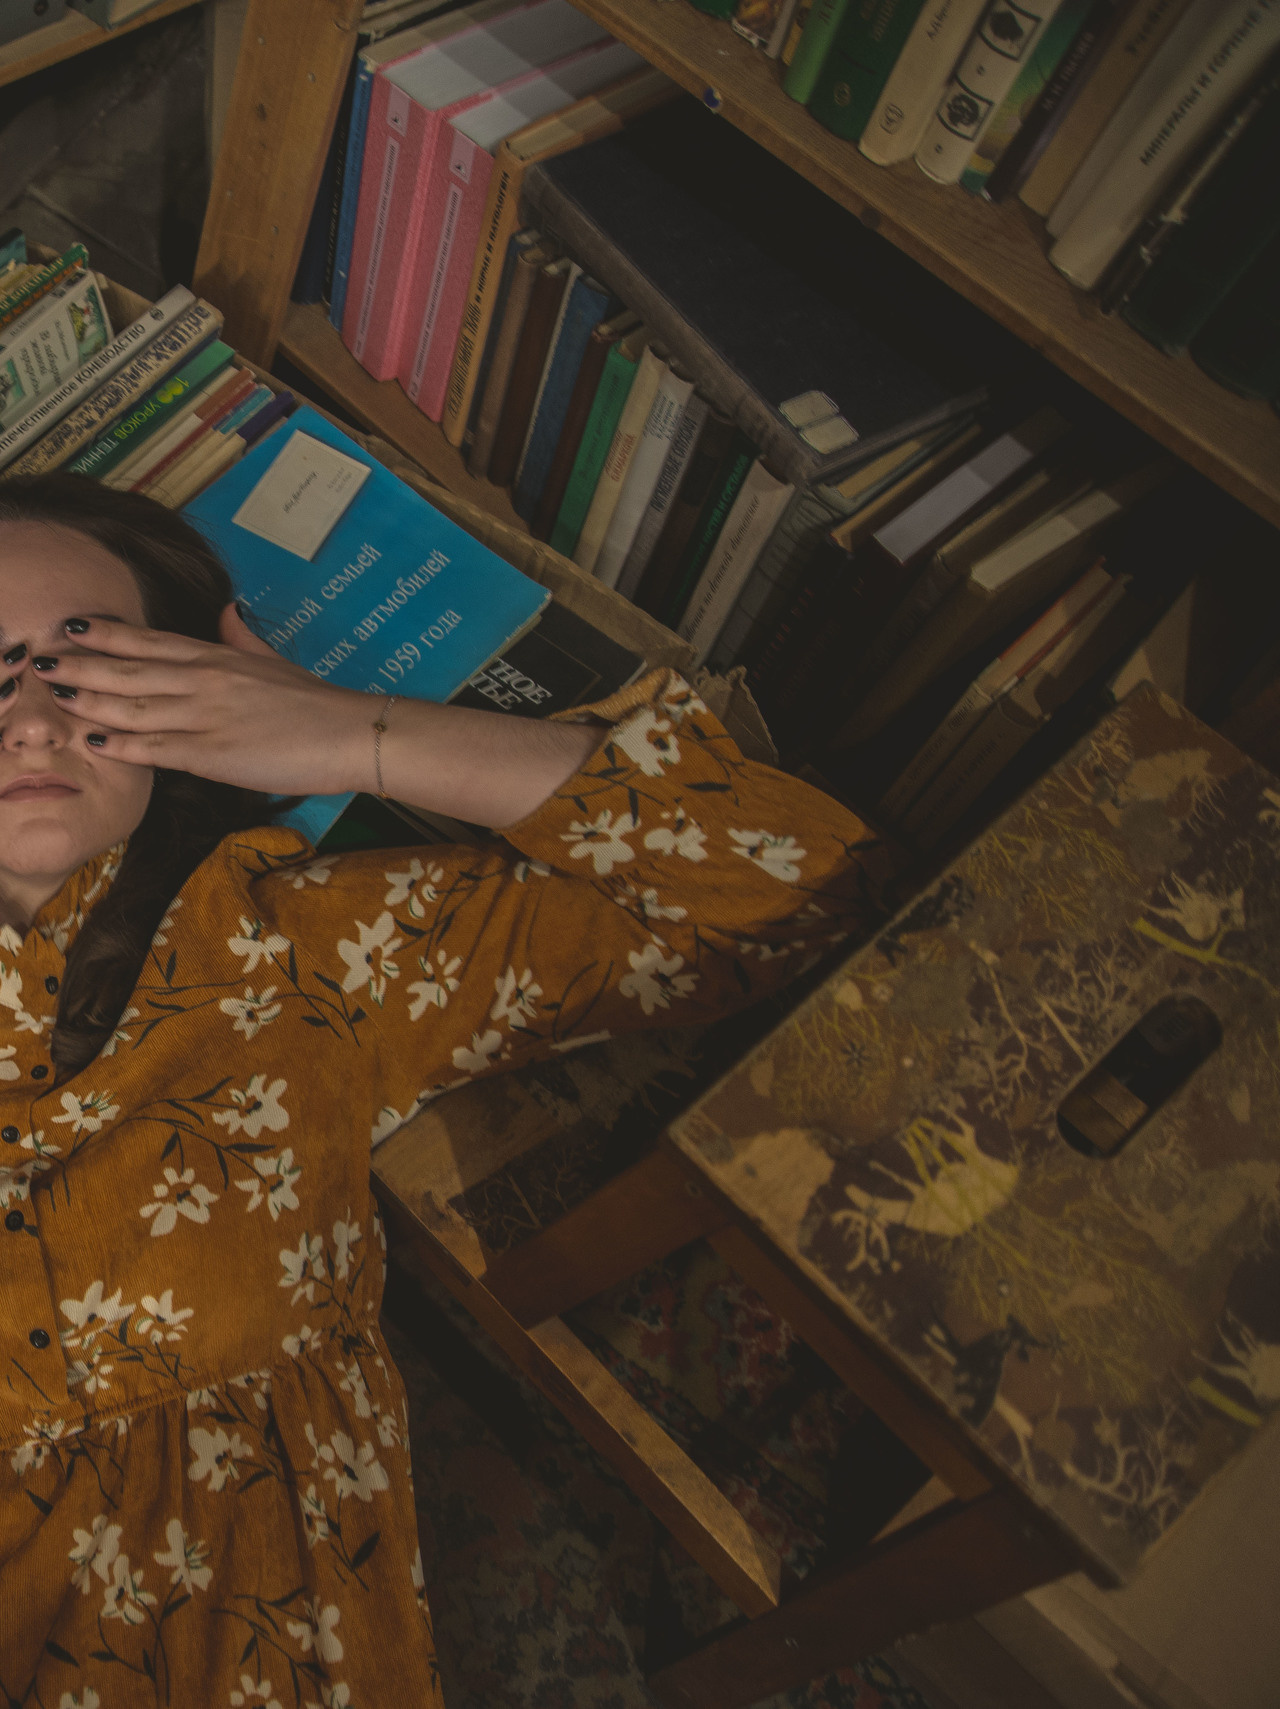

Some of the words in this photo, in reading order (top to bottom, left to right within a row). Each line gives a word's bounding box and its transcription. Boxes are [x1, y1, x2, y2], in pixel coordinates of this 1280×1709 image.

[1136, 85, 1202, 166] МИНЕРАЛЫ
[1194, 71, 1212, 89] И
[1205, 6, 1261, 75] ГОРНЫЕ
[490, 169, 511, 244] ПАТОЛОГИИ
[75, 324, 146, 391] КОНЕВОДСТВО
[114, 400, 163, 441] УРОКОВ
[673, 416, 699, 460] ОПУХОЛИ
[71, 437, 120, 475] ТЕННИС
[717, 452, 751, 502] СУСТАВОВ
[704, 550, 735, 594] детской
[236, 585, 271, 609] т...
[270, 596, 323, 651] льной
[320, 543, 382, 601] семьей
[310, 638, 357, 679] ских
[353, 549, 451, 643] автмобилей
[701, 592, 715, 606] по
[679, 604, 708, 643] авочник
[378, 642, 422, 684] 1959
[419, 610, 463, 649] года
[470, 672, 522, 711] ТЬЕ
[489, 658, 553, 706] НОЕ
